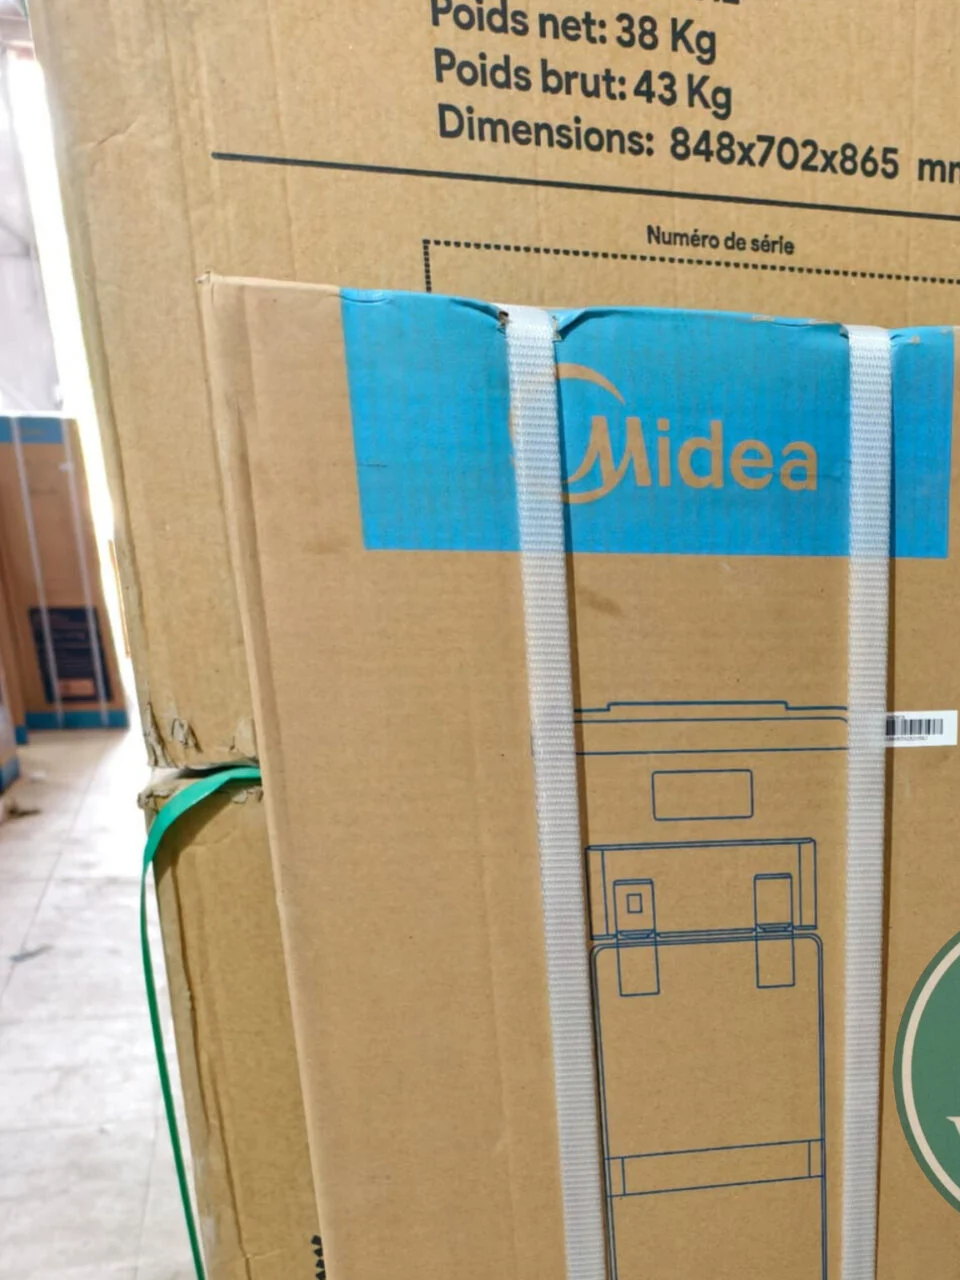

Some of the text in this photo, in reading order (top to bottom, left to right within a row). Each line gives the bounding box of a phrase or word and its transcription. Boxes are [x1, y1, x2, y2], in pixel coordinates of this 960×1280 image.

[431, 0, 717, 66] Poids net: 38 Kg
[434, 47, 733, 120] Poids brut: 43 Kg
[437, 103, 655, 157] Dimensions:
[670, 126, 900, 180] 848x702x865
[646, 224, 795, 256] Numéro de série
[561, 415, 818, 504] Midea
